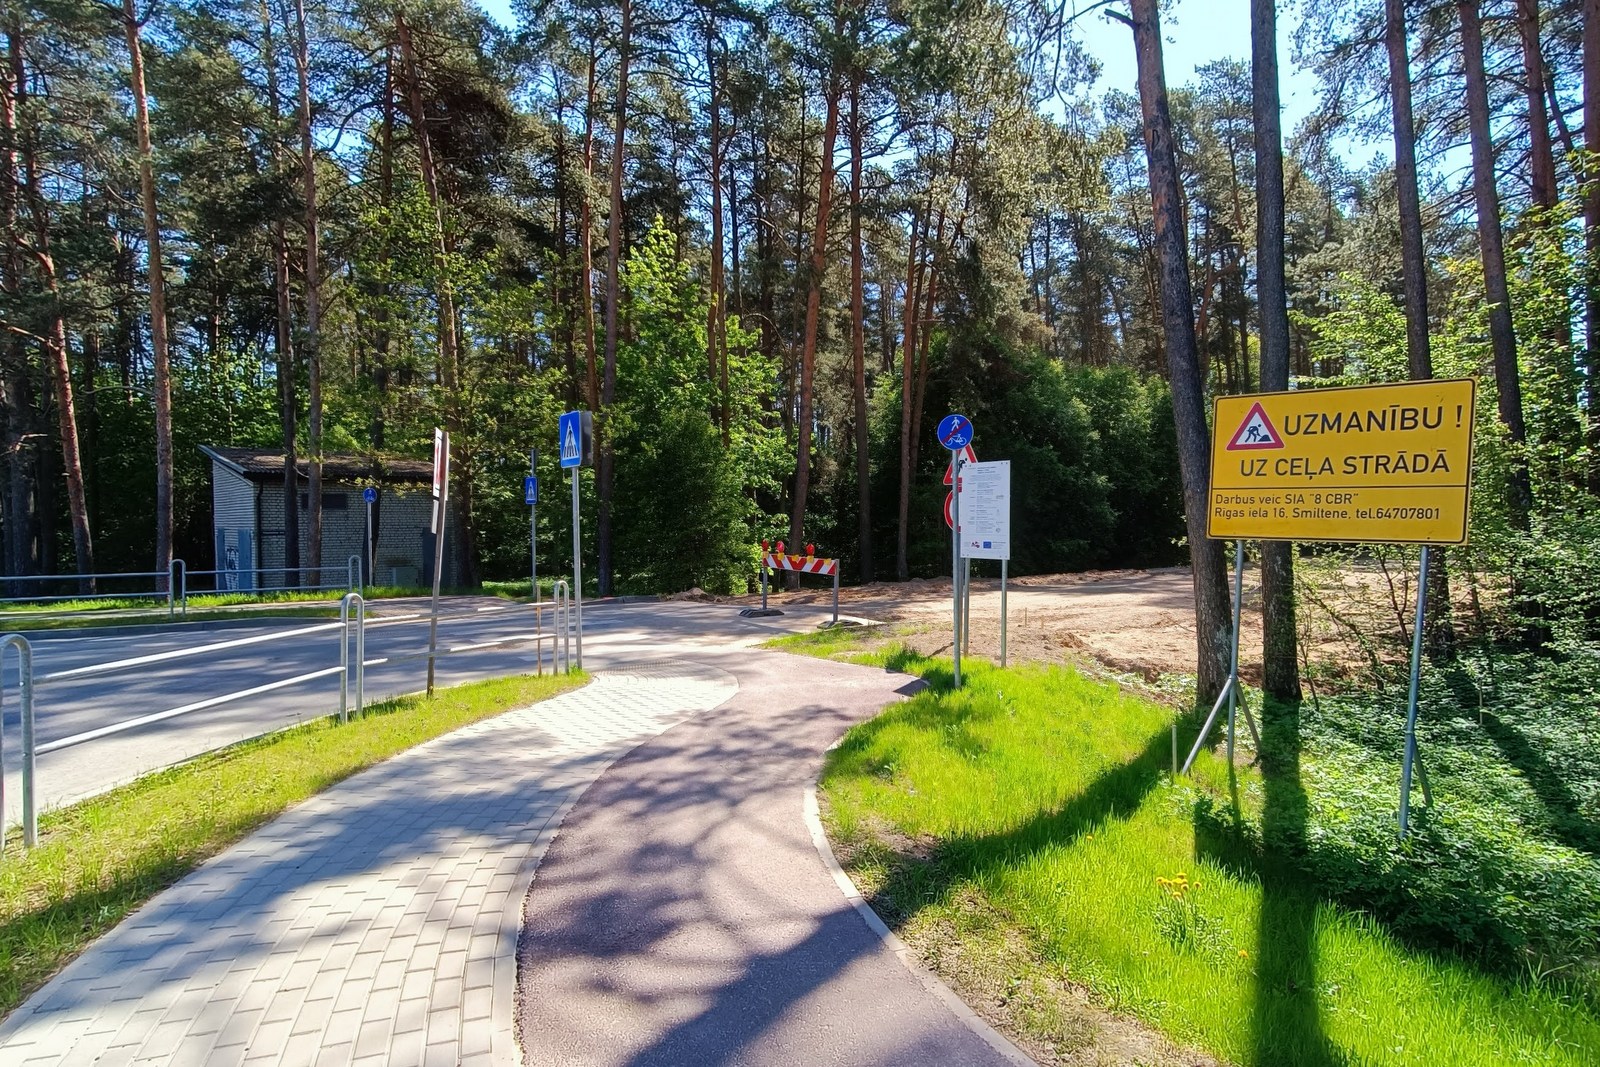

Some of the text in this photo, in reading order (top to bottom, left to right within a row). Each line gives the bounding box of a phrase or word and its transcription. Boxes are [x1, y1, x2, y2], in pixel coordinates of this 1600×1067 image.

[1283, 404, 1463, 436] UZMANĪBU !
[1240, 449, 1450, 480] UZ CEĻA STRĀDĀ
[1215, 493, 1255, 504] Darbus
[1258, 493, 1281, 504] veic
[1284, 493, 1305, 504] SIA
[1248, 507, 1268, 518] iela
[1355, 507, 1440, 520] tel.64707801
